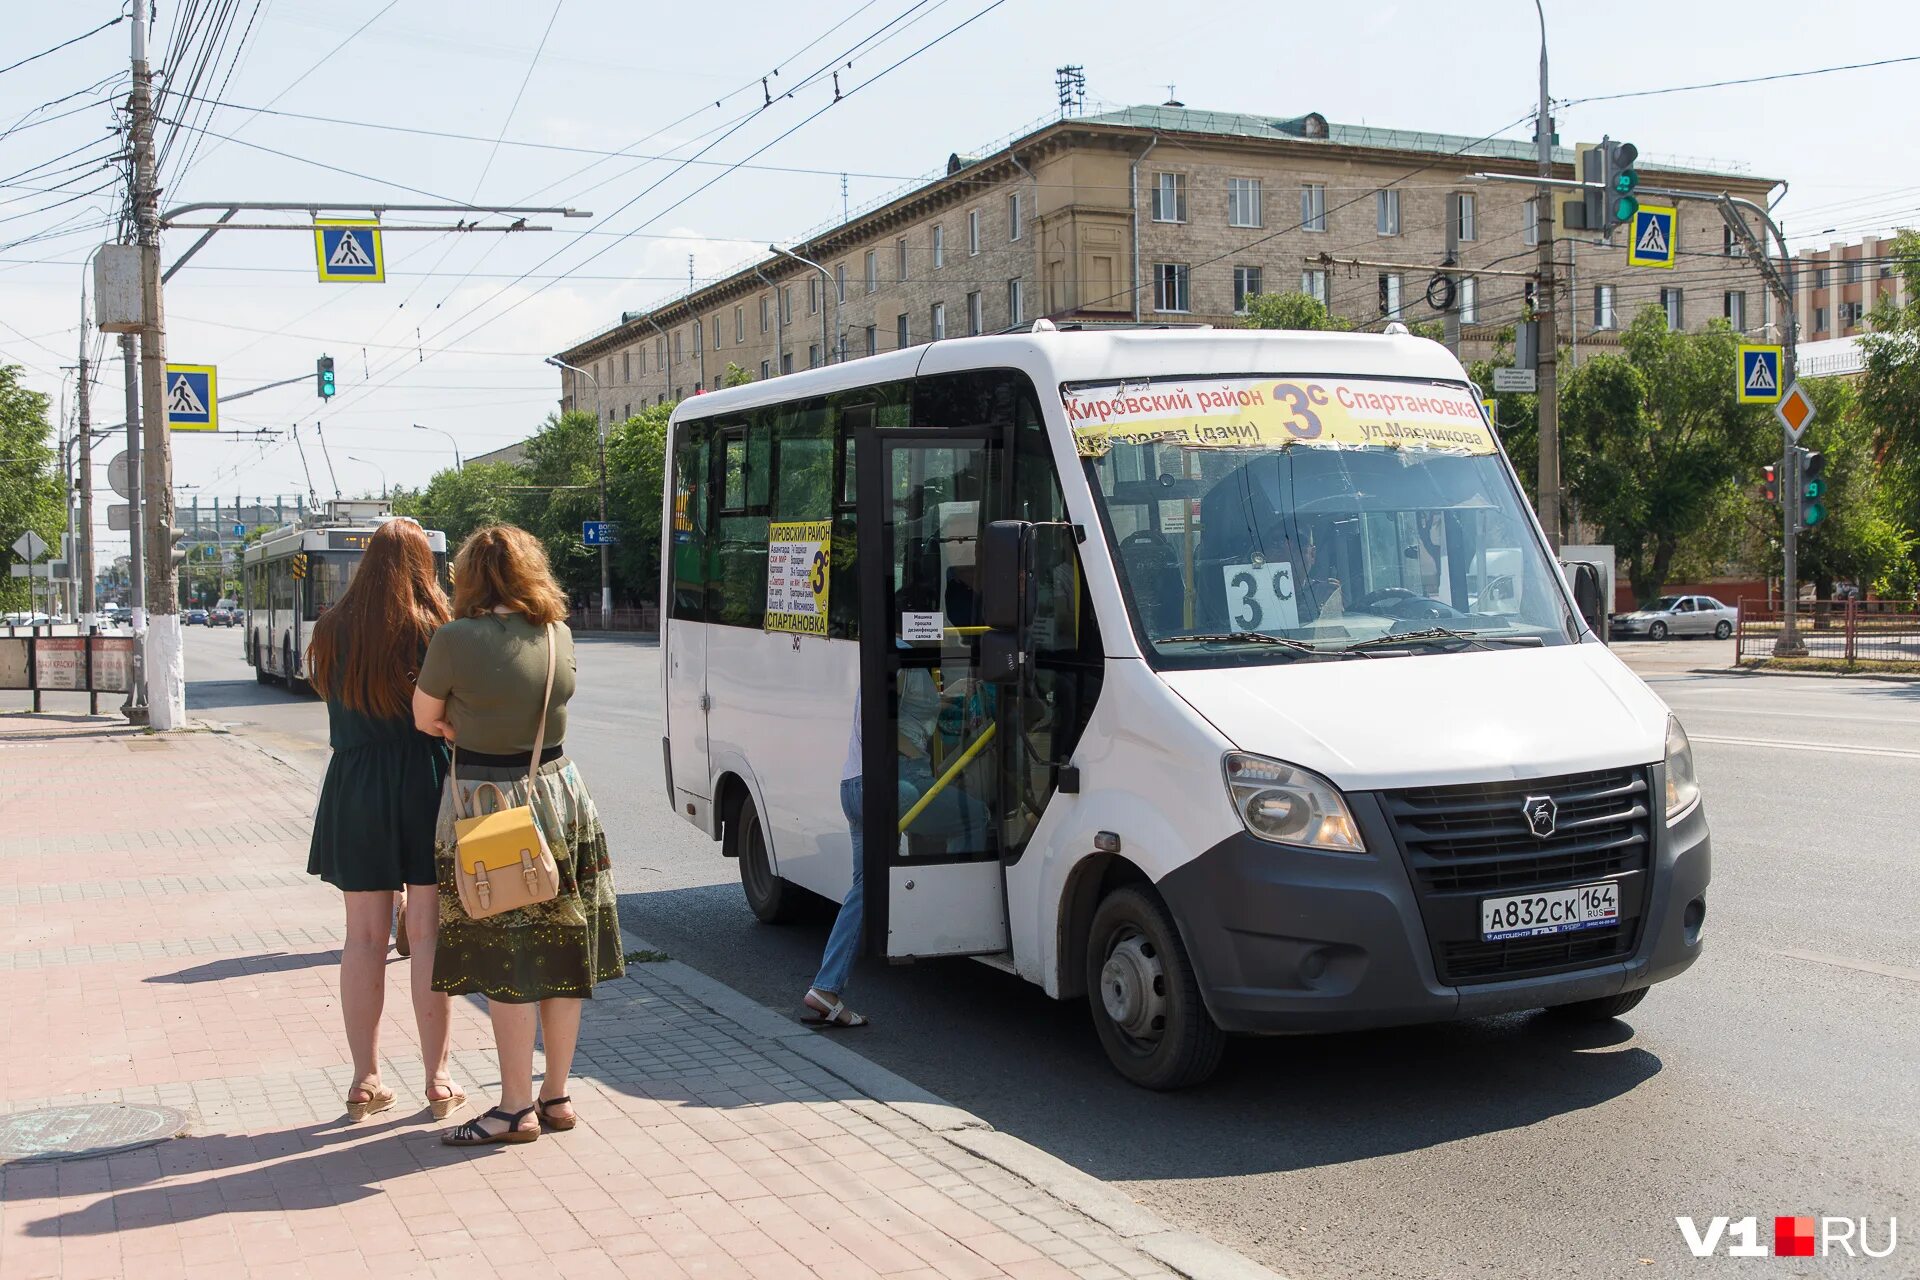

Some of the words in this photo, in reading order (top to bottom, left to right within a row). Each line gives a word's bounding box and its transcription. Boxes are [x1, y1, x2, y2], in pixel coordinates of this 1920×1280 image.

[1067, 387, 1193, 423] Кировский
[1197, 385, 1265, 413] район
[1336, 386, 1479, 419] Спартановка
[1195, 421, 1260, 444] (дачи)
[770, 523, 807, 541] КИРОВСКИЙ
[808, 523, 830, 541] РАЙОН
[768, 612, 825, 632] СПАРТАНОВКА
[1491, 898, 1576, 929] А832СК
[1581, 888, 1613, 910] 164
[1588, 909, 1604, 918] RUS
[1493, 931, 1530, 940] АВТОЦЕНТР
